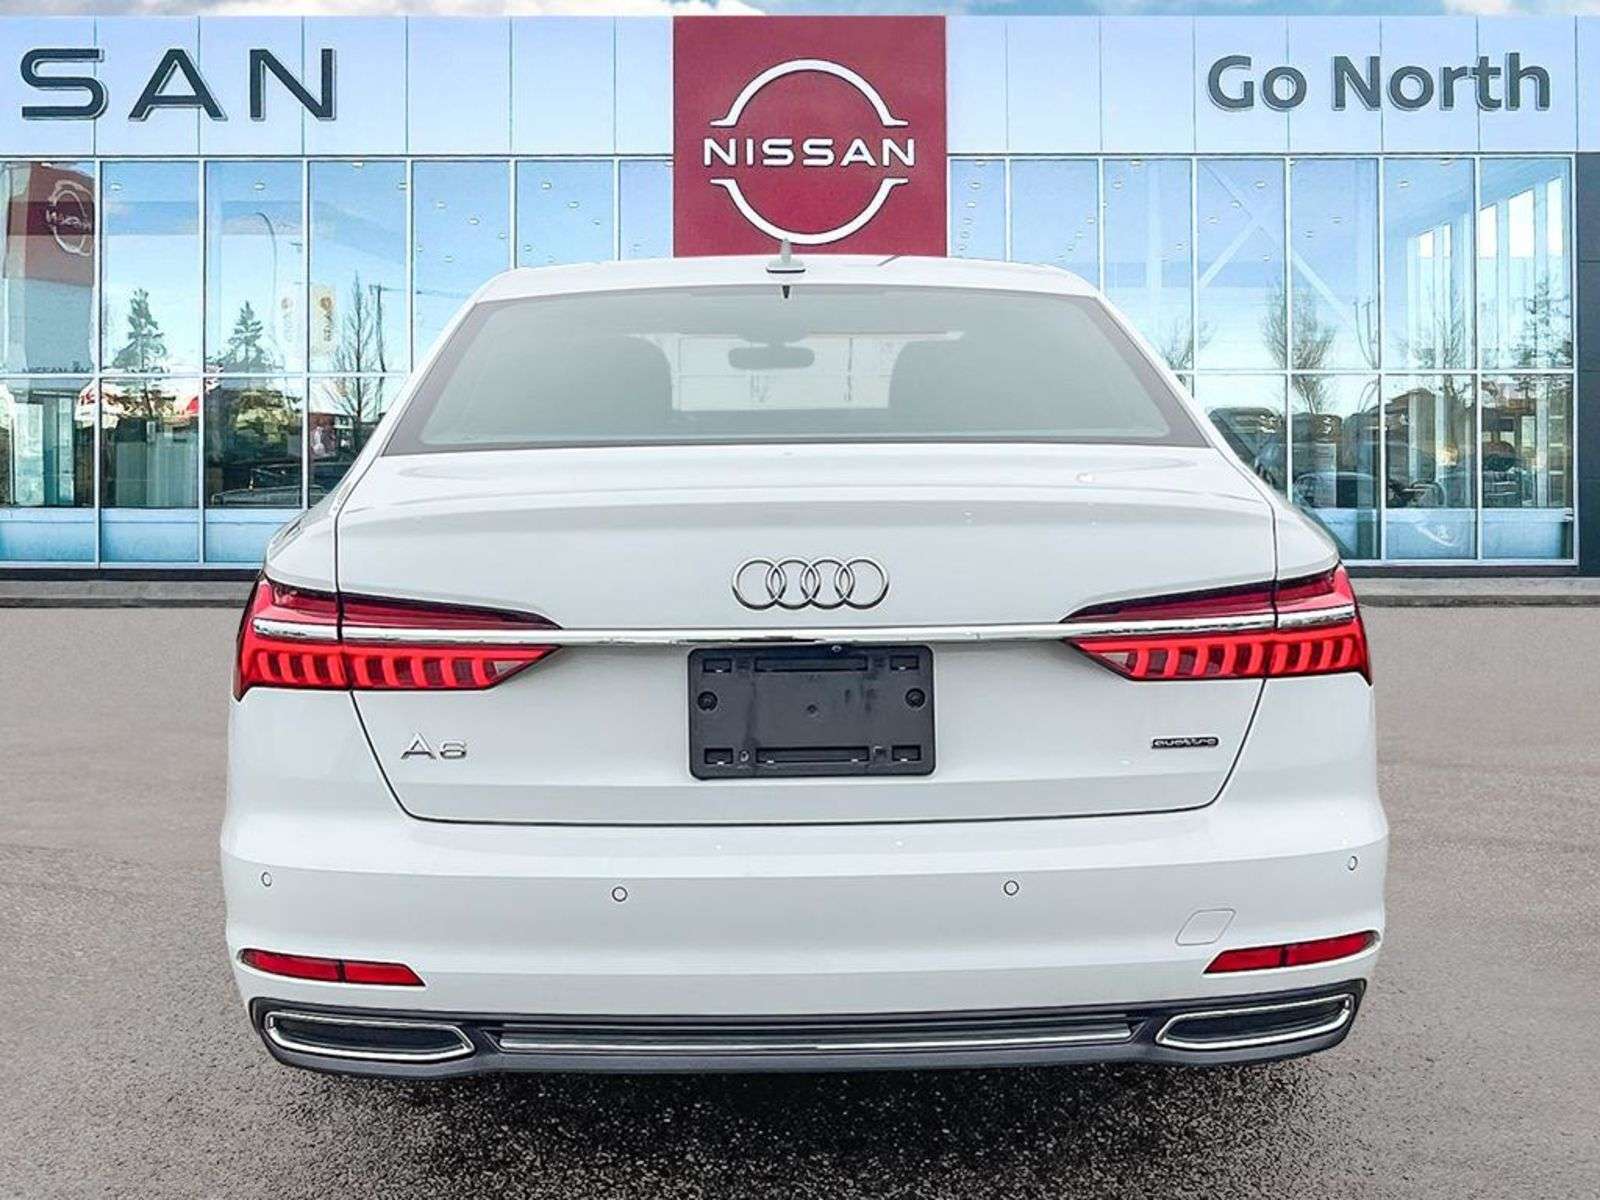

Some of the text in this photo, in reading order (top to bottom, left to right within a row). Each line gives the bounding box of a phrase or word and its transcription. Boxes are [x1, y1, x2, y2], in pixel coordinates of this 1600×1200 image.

[20, 48, 337, 121] SAN
[1207, 52, 1551, 111] Go North
[703, 137, 916, 167] NISSAN
[400, 732, 467, 760] A6
